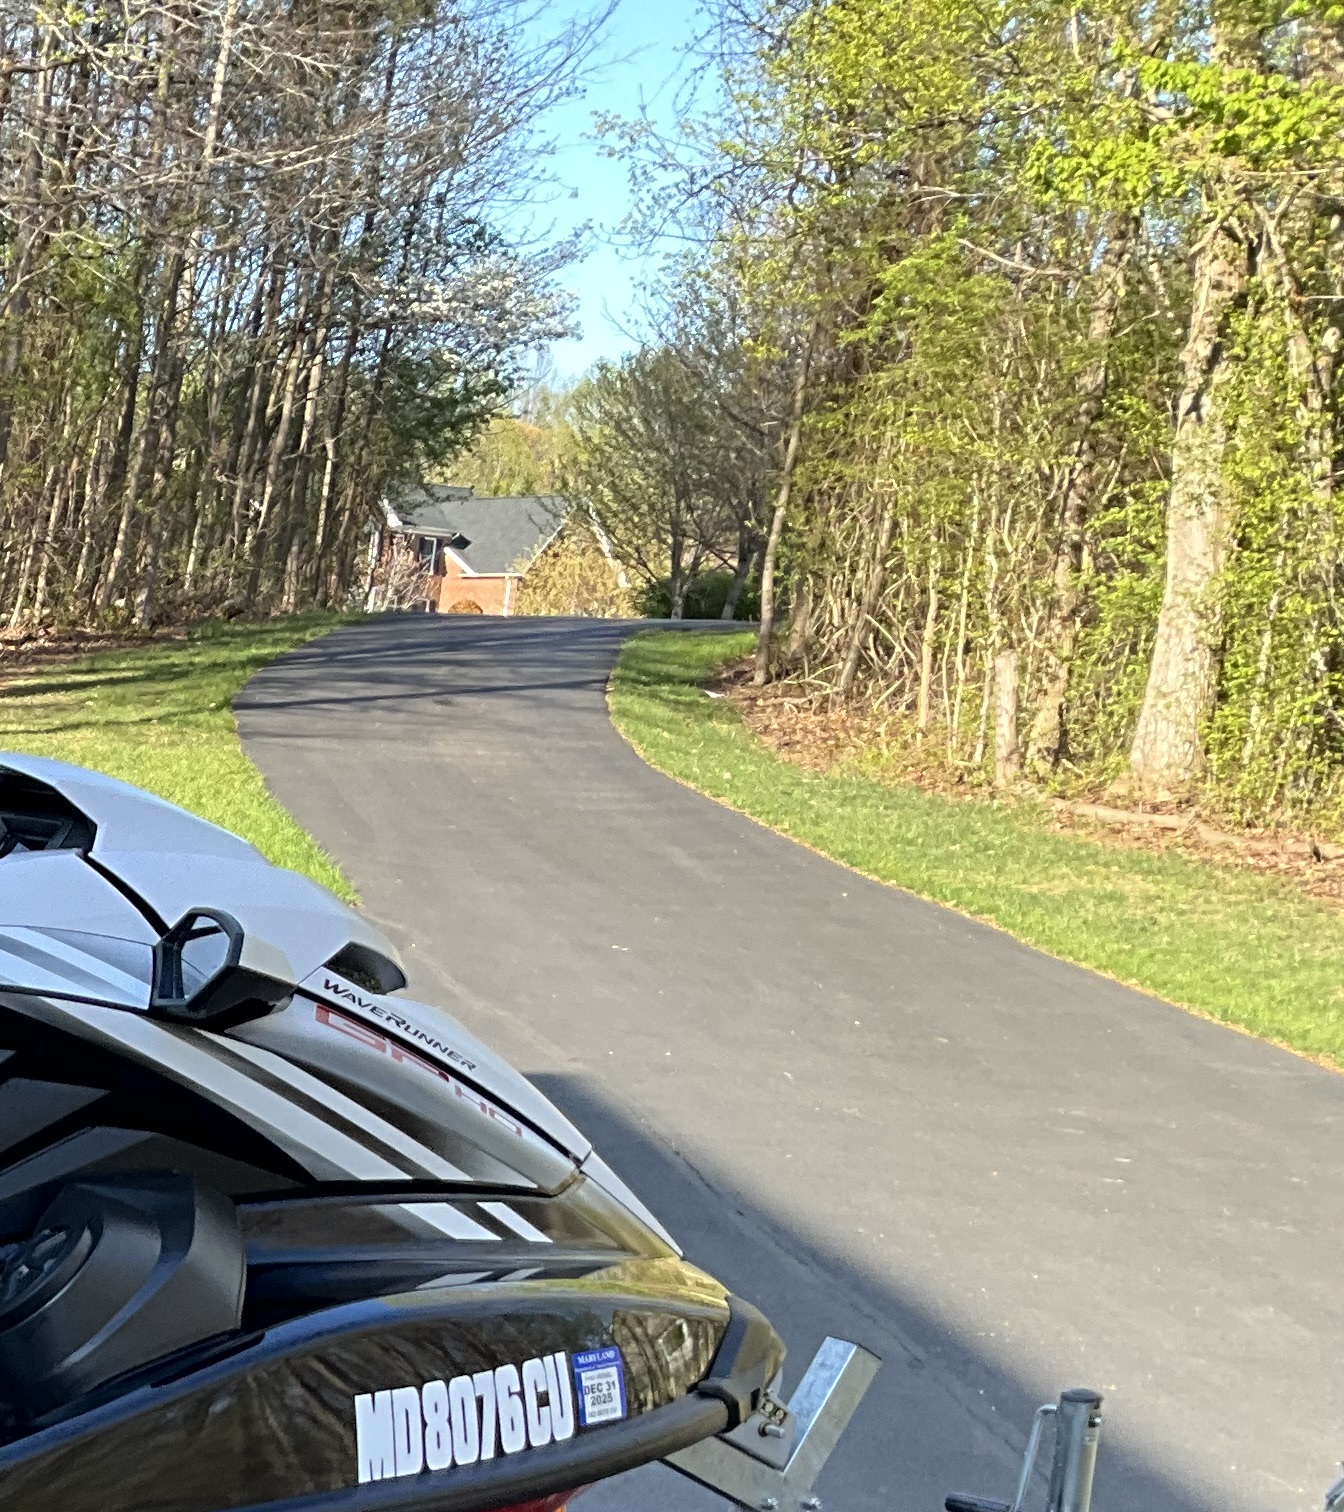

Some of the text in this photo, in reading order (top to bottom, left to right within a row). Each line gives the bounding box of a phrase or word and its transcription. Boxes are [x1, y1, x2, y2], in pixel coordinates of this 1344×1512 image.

[577, 1350, 615, 1364] MARYLAND
[583, 1380, 616, 1396] DEC 31
[590, 1393, 613, 1406] 2025
